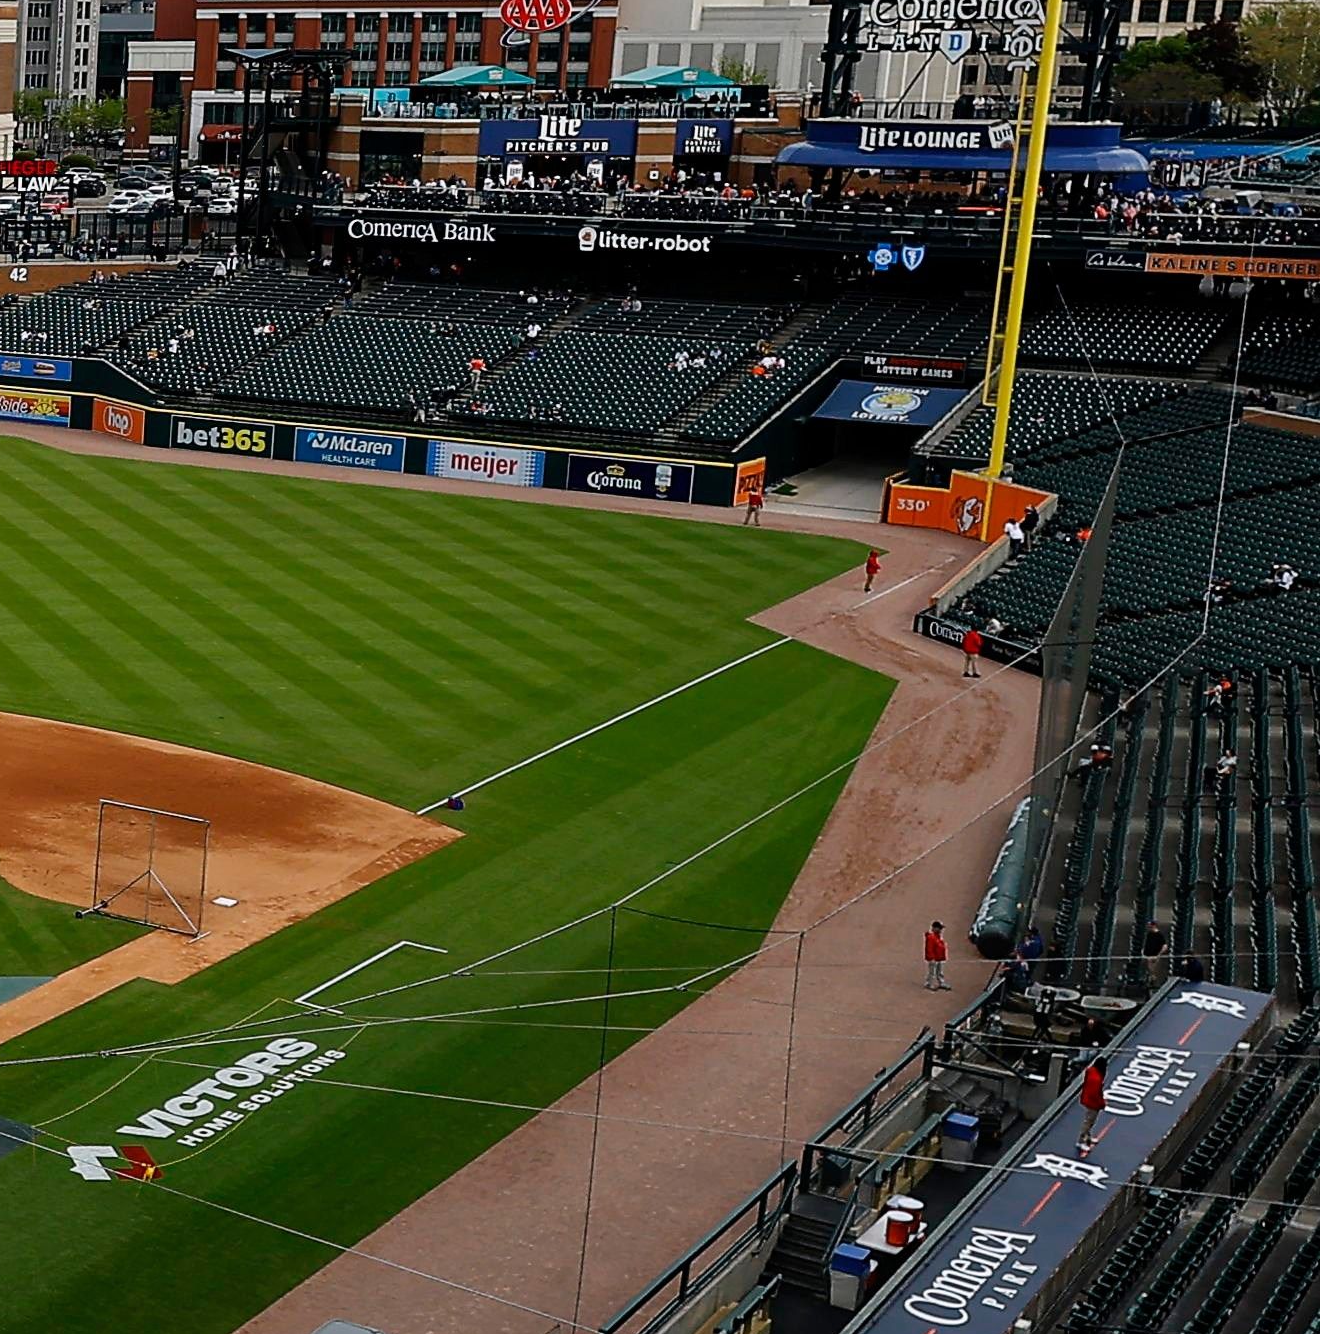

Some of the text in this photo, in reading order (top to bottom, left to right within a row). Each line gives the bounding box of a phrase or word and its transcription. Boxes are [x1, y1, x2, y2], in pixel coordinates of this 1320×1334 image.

[538, 114, 583, 142] Lite
[859, 126, 981, 152] Lite LOUNGE
[505, 141, 609, 152] PITCHER'S PUB
[0, 160, 58, 176] FIEGER
[18, 177, 55, 192] LAW
[443, 222, 496, 242] Bank
[10, 268, 28, 282] 42
[1244, 261, 1318, 277] CORNER
[864, 355, 887, 365] PLAY
[876, 366, 953, 378] LOTTERY GAMES
[107, 406, 129, 435] hap
[176, 421, 266, 453] bet365
[328, 435, 393, 457] McLaren
[321, 454, 377, 467] HEALTH CARE
[450, 450, 518, 479] meijer
[586, 470, 642, 492] Corona
[896, 498, 930, 512] 330'
[115, 1037, 318, 1139] VICTORS
[176, 1048, 347, 1148] HOME SOLUTIONS
[1154, 1068, 1198, 1106] PARK
[981, 1259, 1039, 1311] PARK
